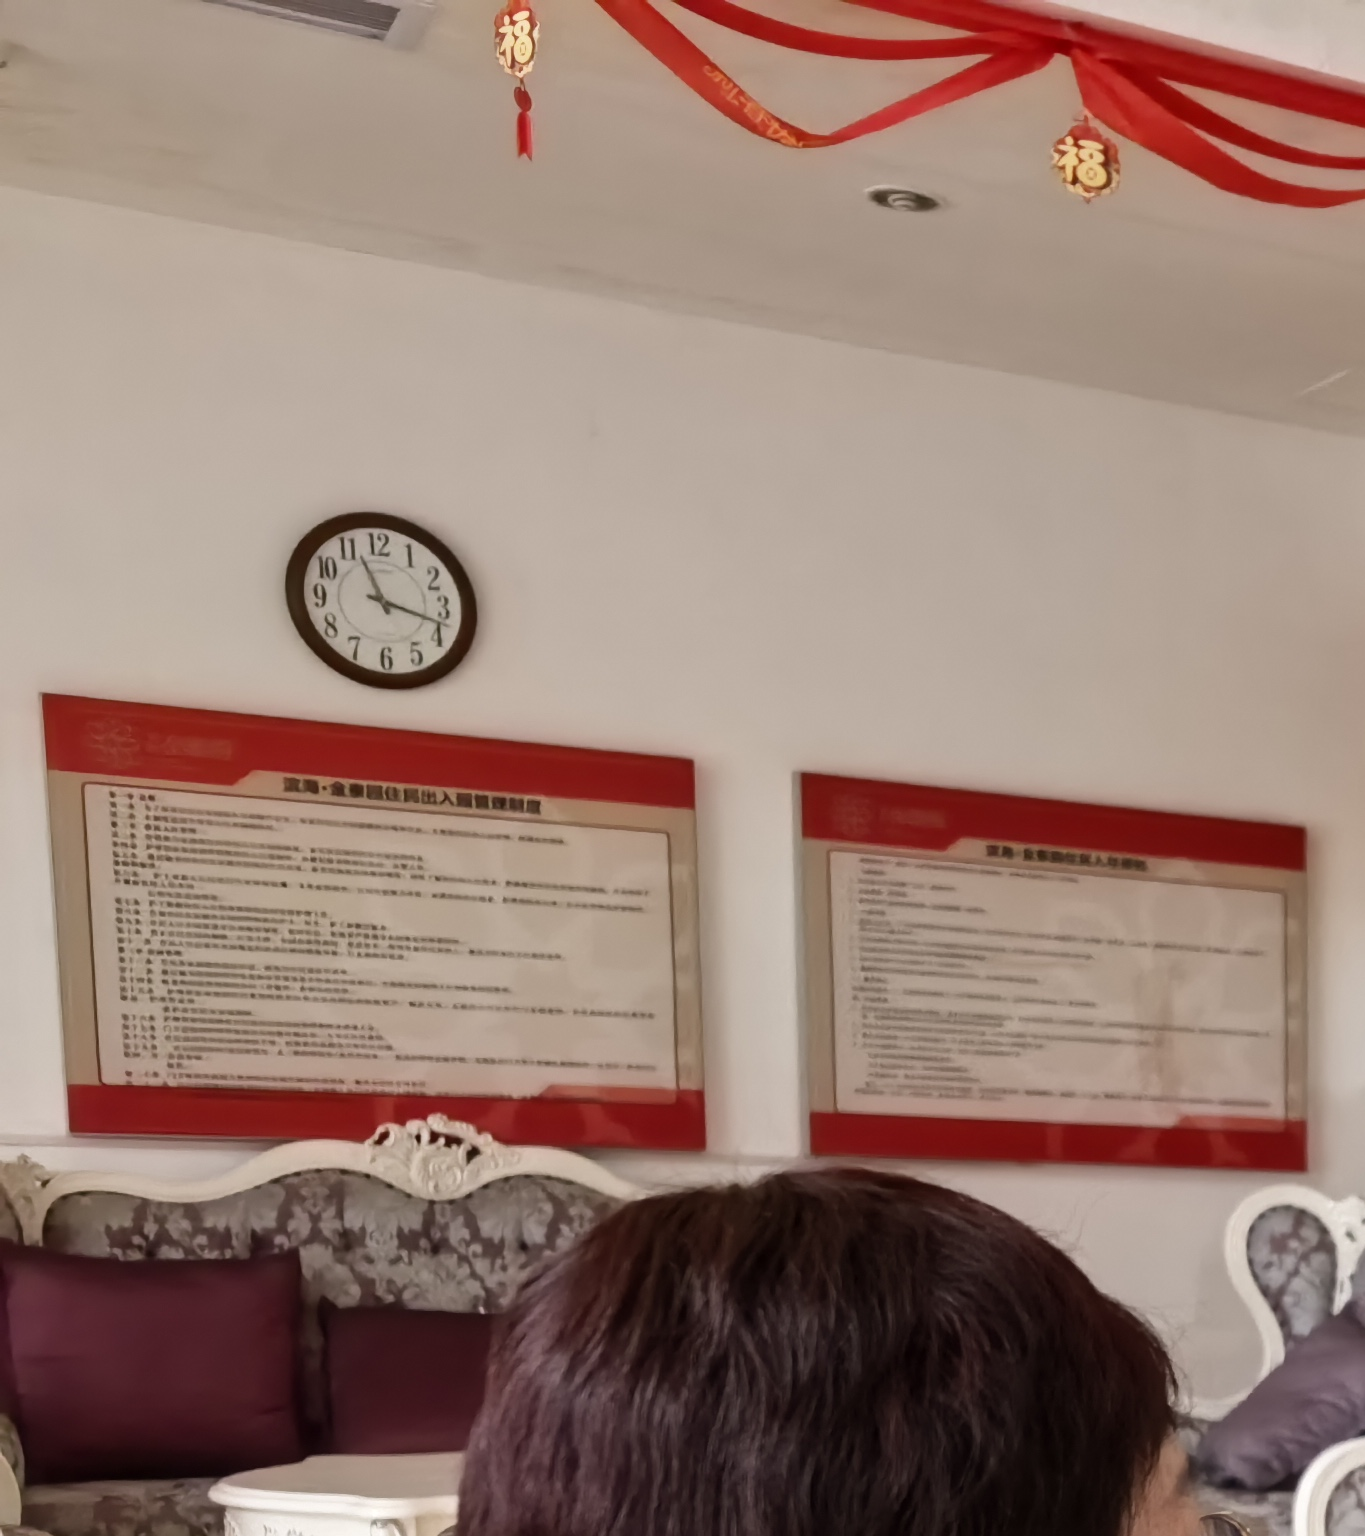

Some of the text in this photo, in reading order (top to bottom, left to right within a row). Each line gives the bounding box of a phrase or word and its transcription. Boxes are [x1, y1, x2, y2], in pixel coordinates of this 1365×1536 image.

[499, 11, 532, 68] 福
[1057, 136, 1107, 187] 福
[340, 537, 355, 560] 11
[368, 533, 390, 557] 12
[405, 543, 414, 568] 1
[318, 556, 337, 580] 10
[427, 567, 440, 591] 2
[313, 584, 326, 607] 9
[437, 596, 450, 620] 3
[324, 613, 338, 638] 8
[348, 637, 360, 661] 7
[381, 647, 393, 670] 6
[410, 642, 423, 666] 5
